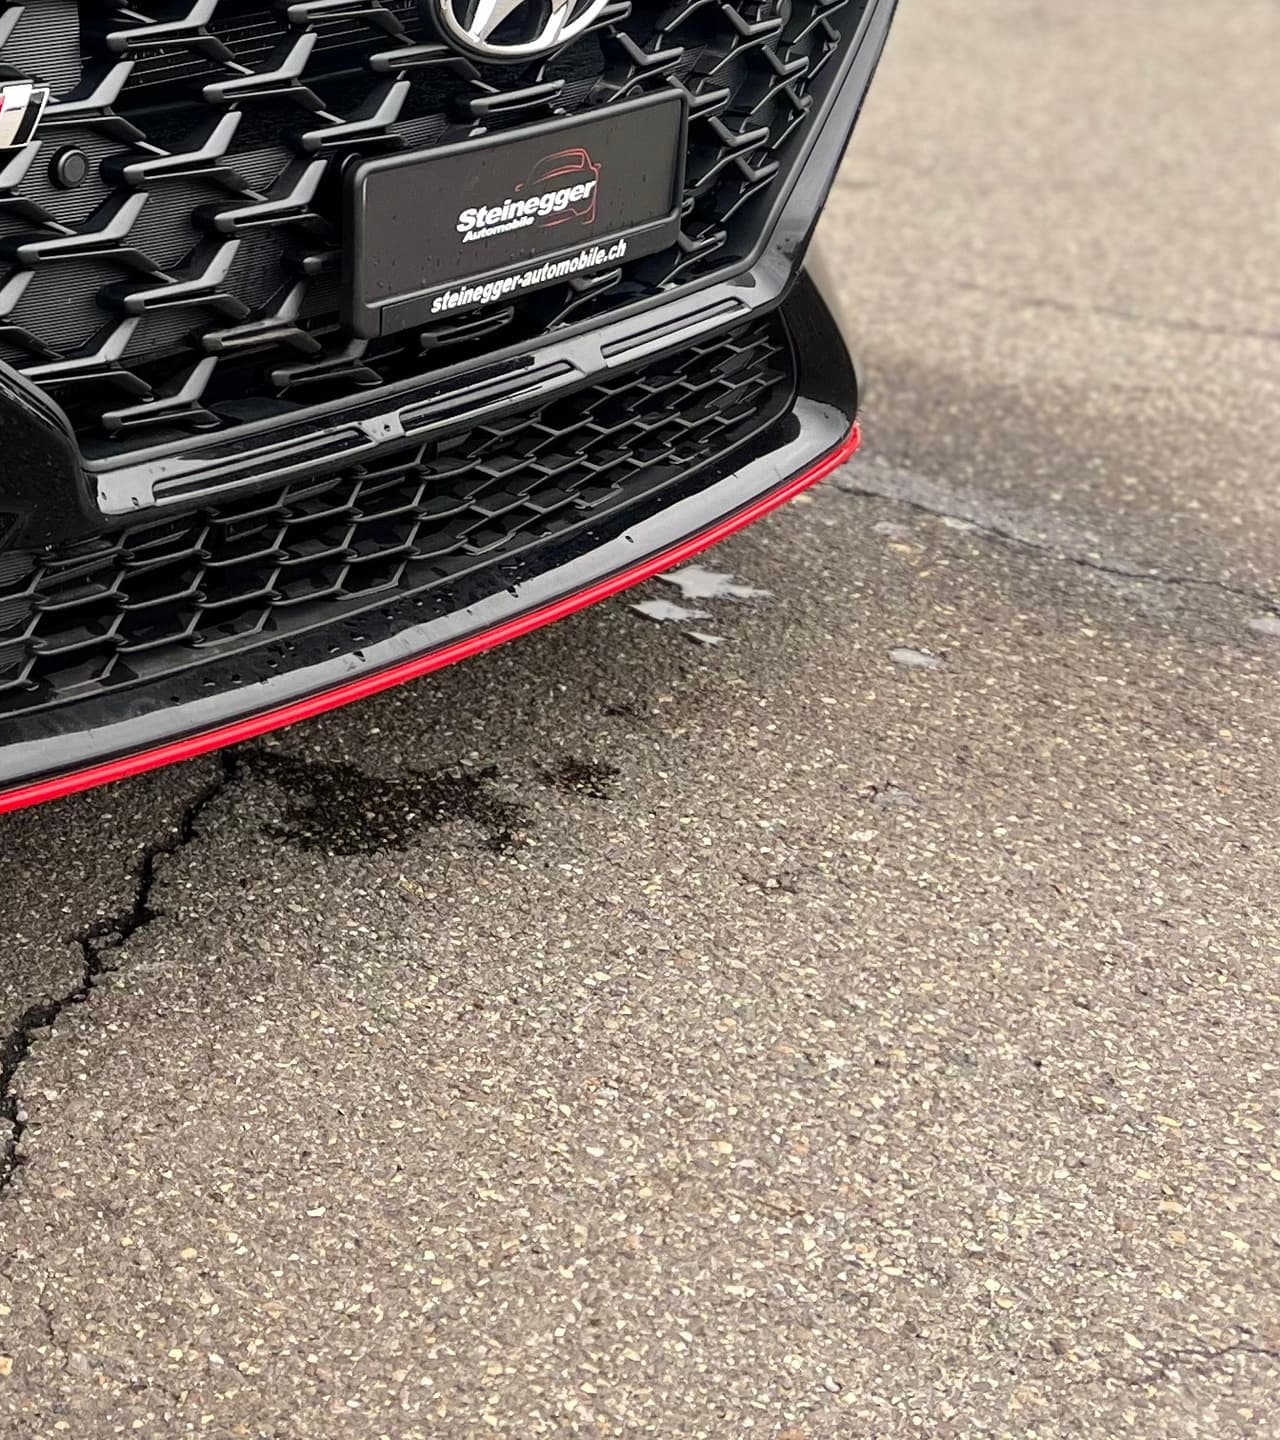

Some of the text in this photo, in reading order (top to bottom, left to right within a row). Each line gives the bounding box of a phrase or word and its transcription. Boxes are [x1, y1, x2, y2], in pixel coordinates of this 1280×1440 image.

[456, 180, 597, 233] Steinegger
[462, 216, 535, 243] Automobile
[430, 239, 627, 314] steinegger-automobile.ch
